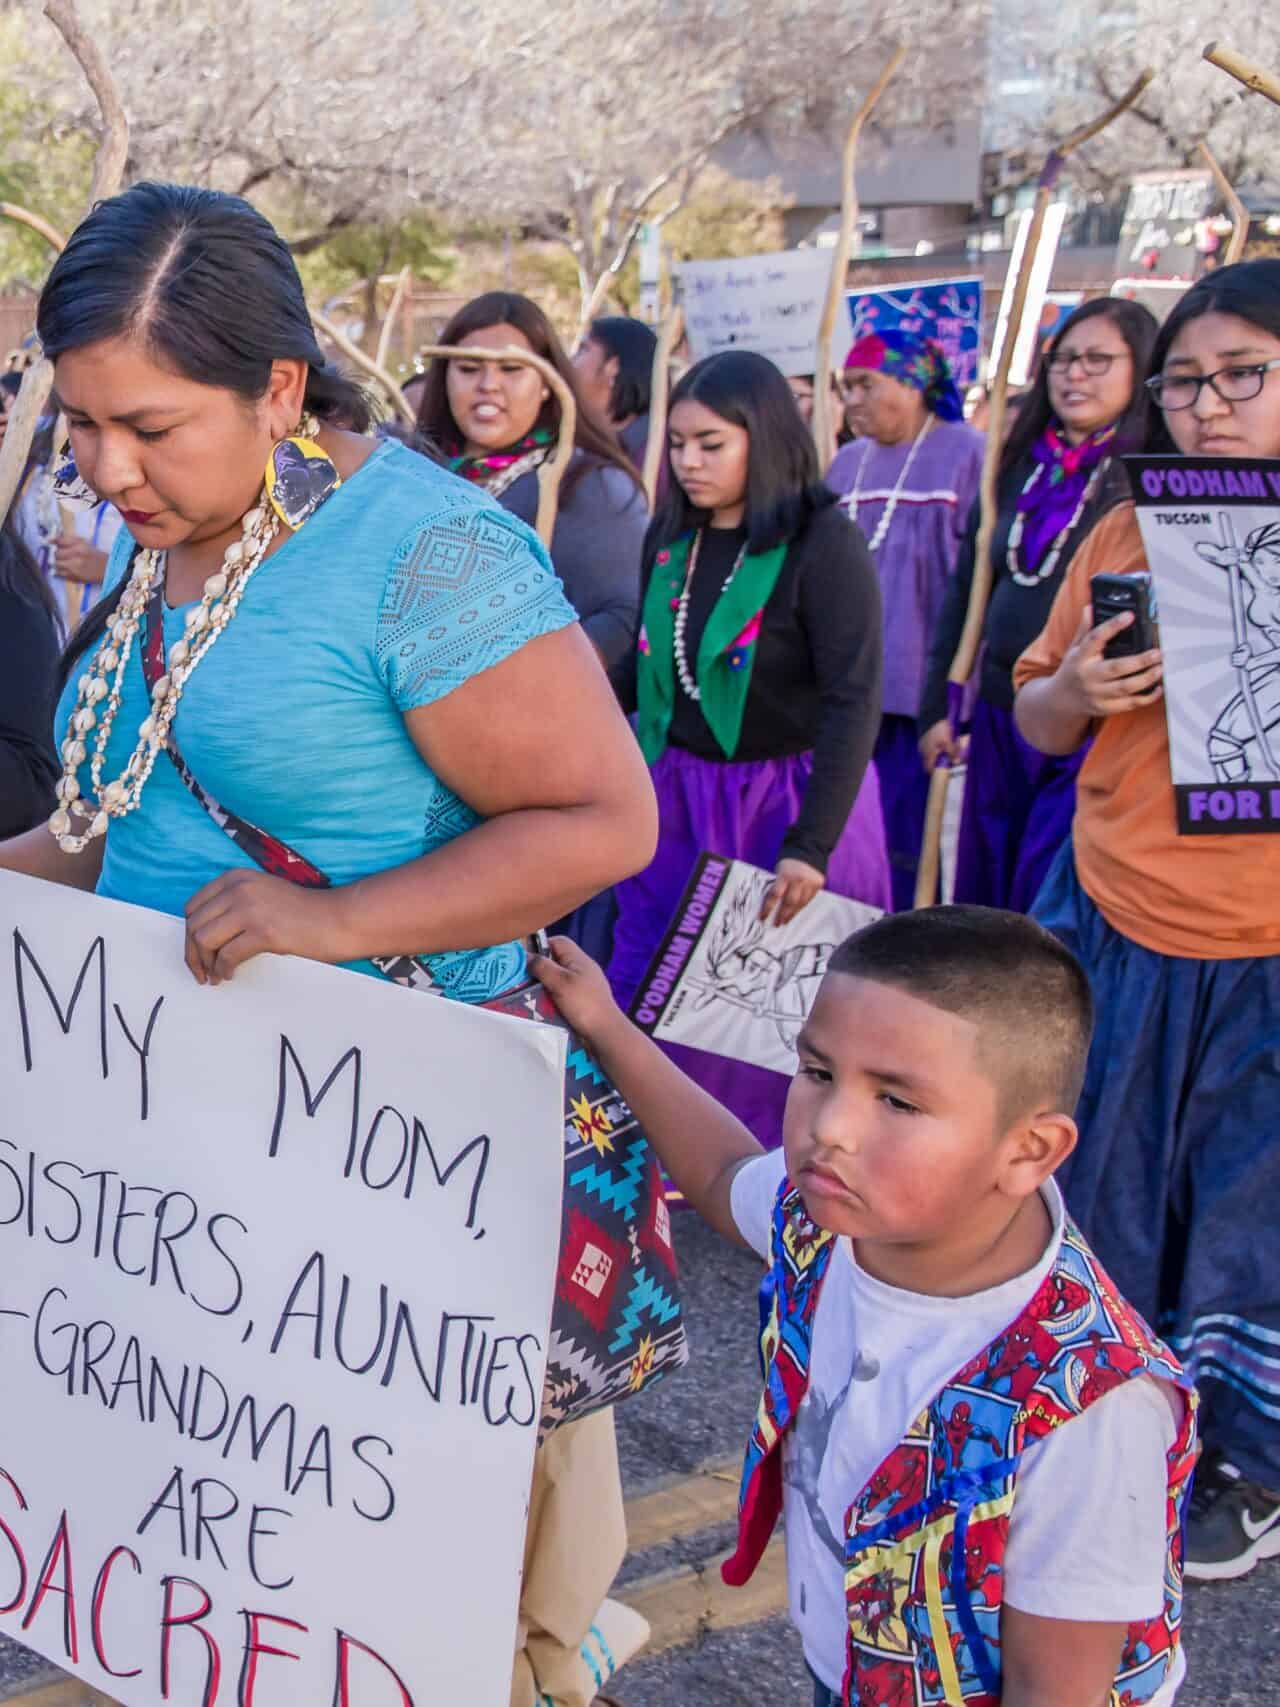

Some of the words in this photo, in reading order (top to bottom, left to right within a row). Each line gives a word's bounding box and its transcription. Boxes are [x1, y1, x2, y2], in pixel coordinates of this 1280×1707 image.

[1141, 468, 1267, 499] O'ODHAM
[1155, 512, 1212, 526] TUCSON
[1187, 790, 1261, 822] FOR
[634, 934, 694, 1024] O'ODHAM
[677, 859, 728, 935] WOMEN
[269, 1033, 491, 1241] MOM,
[33, 1286, 396, 1523] GRANDMAS
[270, 1250, 541, 1429] AUNTIES
[135, 1465, 295, 1591] ARE
